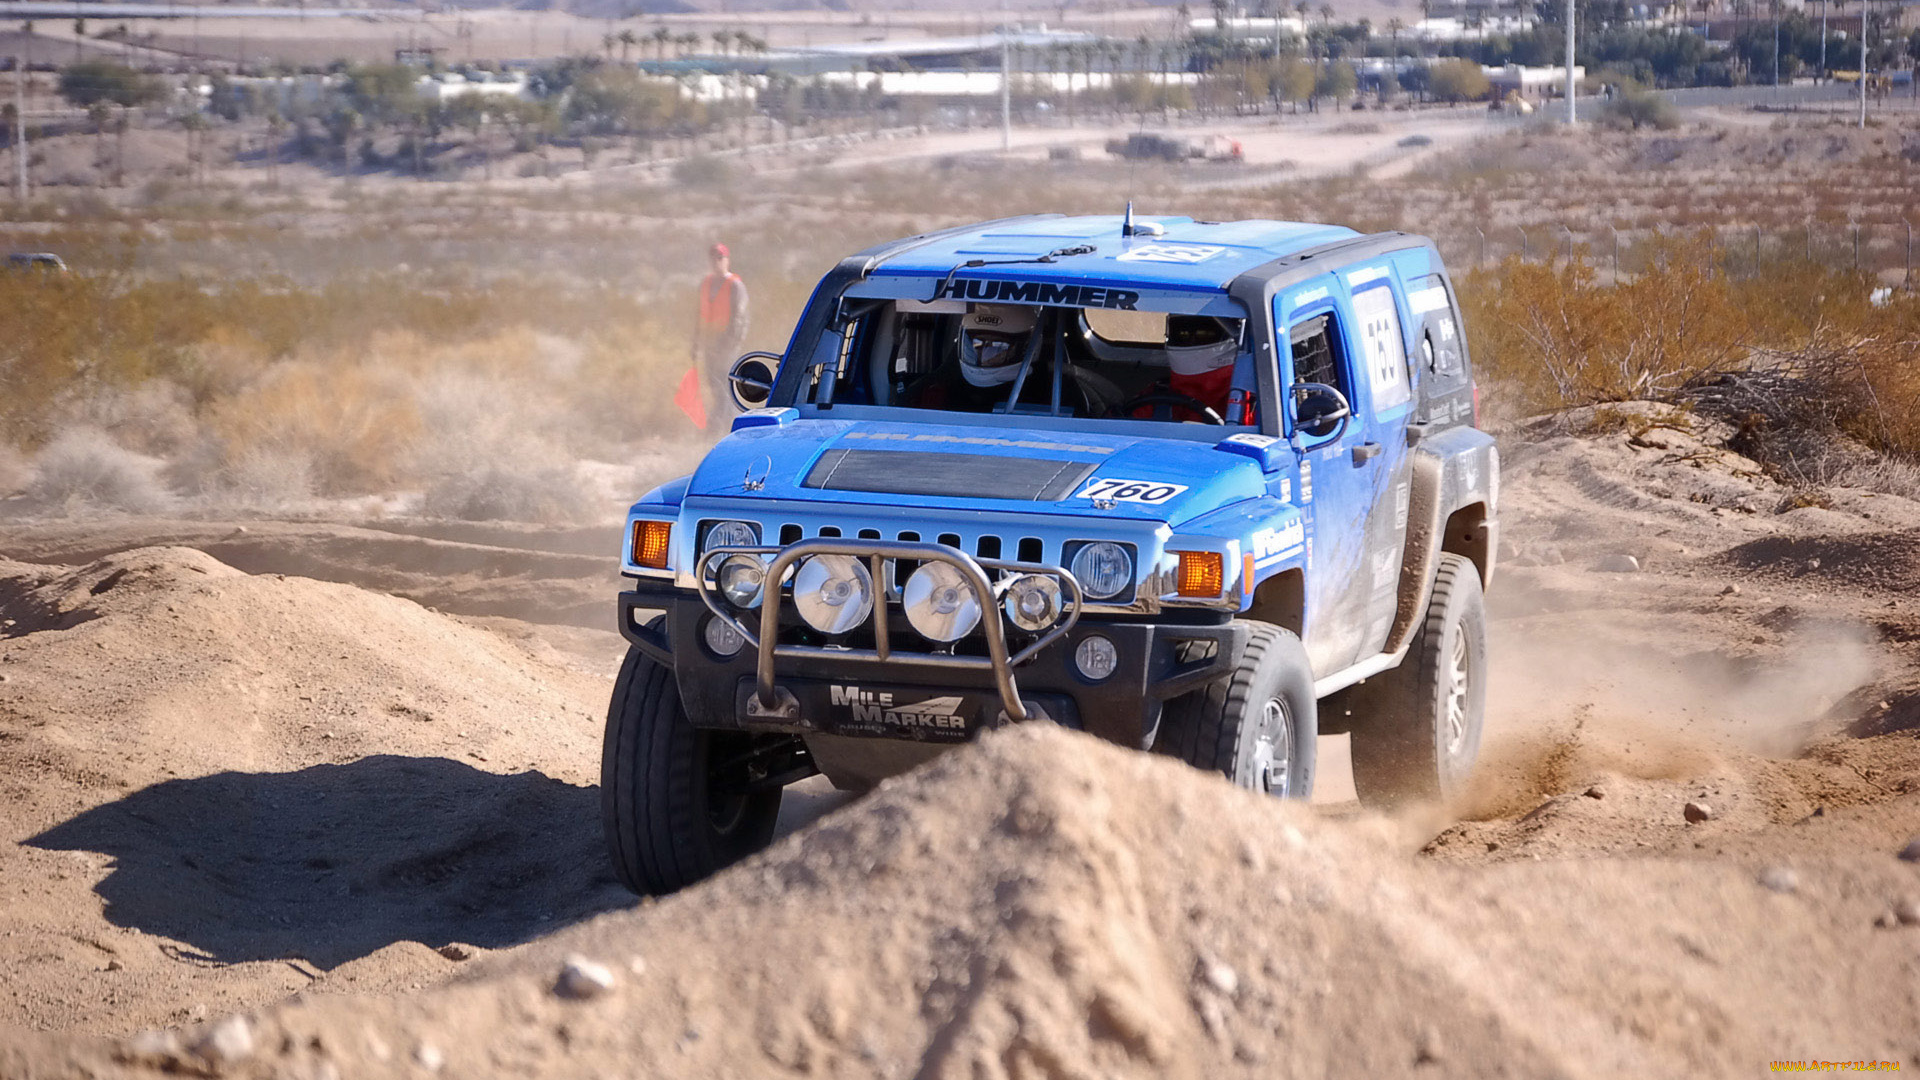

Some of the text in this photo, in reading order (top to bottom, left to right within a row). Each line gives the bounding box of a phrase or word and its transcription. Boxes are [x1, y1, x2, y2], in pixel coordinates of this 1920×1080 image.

[934, 278, 1140, 312] HUMMER
[977, 315, 1000, 324] SHOEI
[1367, 318, 1397, 385] 760
[1092, 481, 1176, 502] 760
[830, 684, 894, 707] MILE
[852, 701, 966, 729] MARKER
